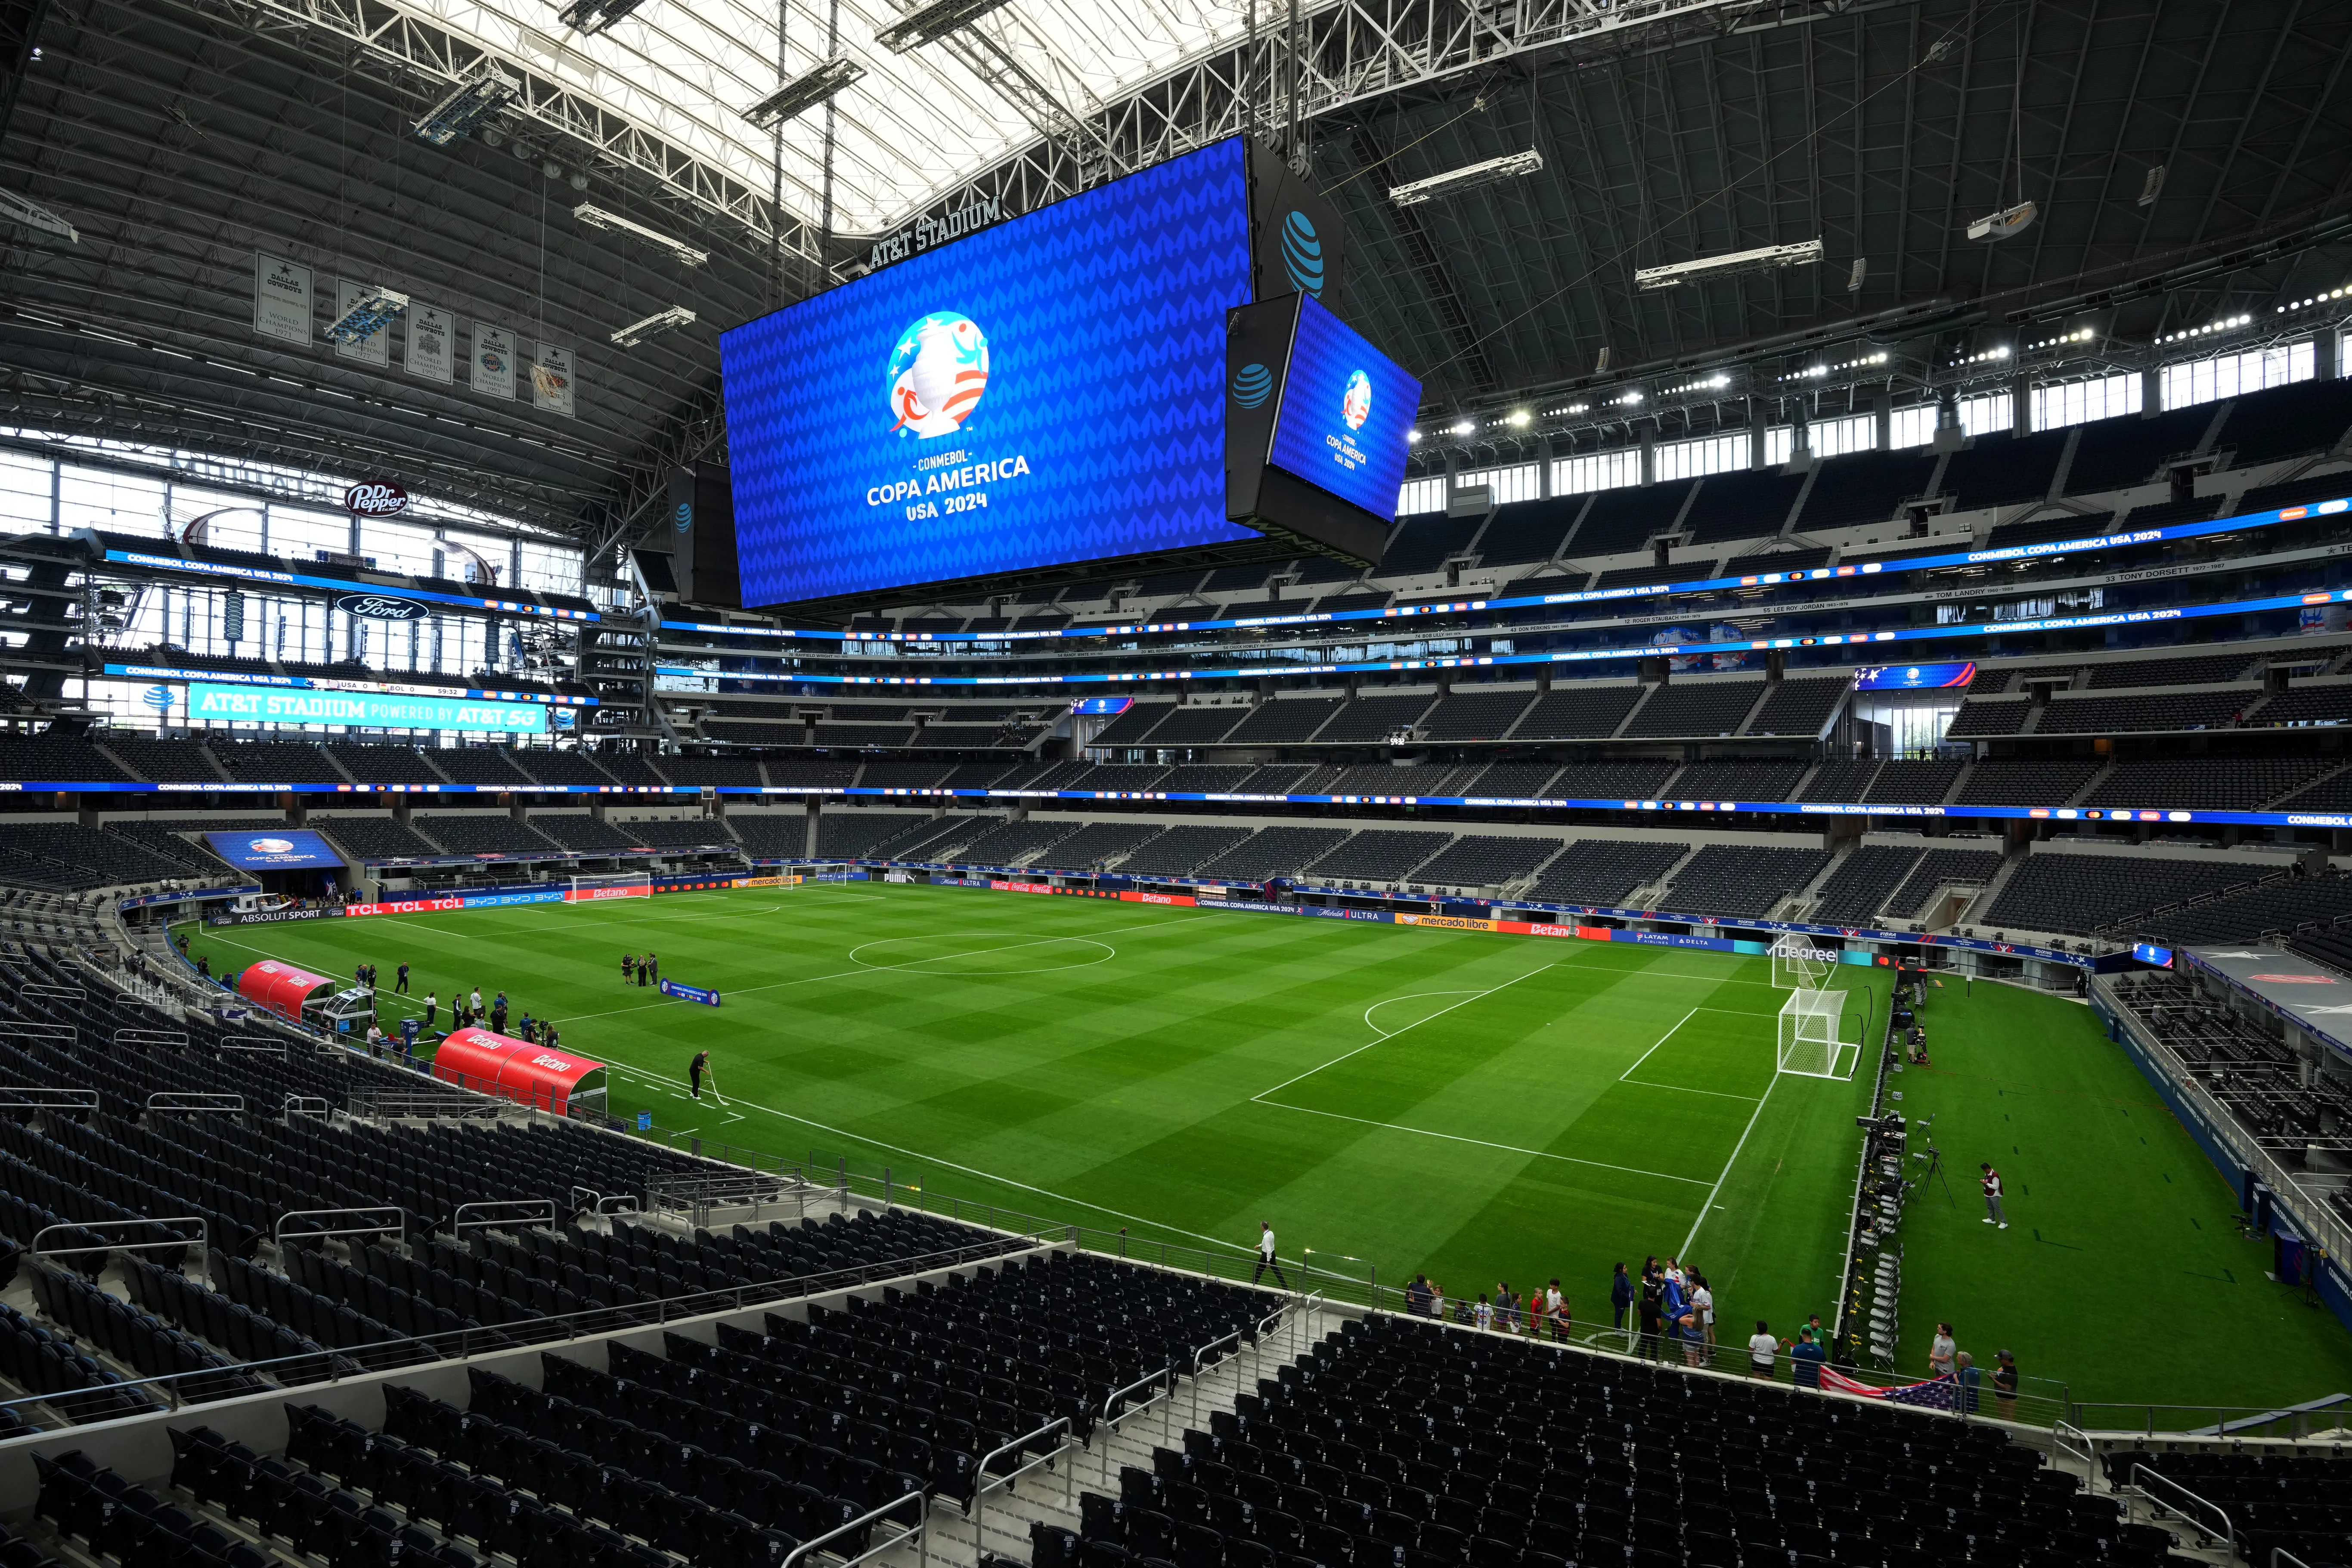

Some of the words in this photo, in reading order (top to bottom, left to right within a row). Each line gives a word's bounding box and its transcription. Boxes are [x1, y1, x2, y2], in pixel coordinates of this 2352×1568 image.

[870, 231, 912, 270] AT&T
[915, 195, 1001, 251] STADIUM
[271, 273, 299, 287] DALLAS
[267, 279, 302, 294] COWBOYS
[269, 312, 298, 325] WORLD
[419, 319, 442, 330] DALLAS
[259, 316, 307, 335] CHAMPIONS
[416, 324, 445, 336] COWBOYS
[276, 328, 291, 338] 1971
[481, 344, 508, 355] COWBOYS
[484, 339, 505, 349] DALLAS
[355, 351, 371, 359] 1977
[417, 353, 441, 365] WORLD
[409, 358, 449, 373] CHAMPIONS
[542, 363, 567, 373] COWBOYS
[545, 358, 565, 367] DALLAS
[422, 369, 437, 377] 1992
[483, 372, 505, 383] WORLD
[475, 377, 511, 390] CHAMPIONS
[1326, 434, 1342, 451] COPA
[1342, 444, 1367, 465] AMERICA
[1335, 452, 1343, 465] USA
[1344, 458, 1355, 471] 2024
[867, 479, 921, 506] COPA
[926, 455, 1030, 495] AMERICA
[372, 485, 395, 499] Dr
[348, 485, 406, 512] Pepper
[906, 502, 938, 521] USA
[945, 493, 987, 514] 2024
[1968, 547, 2027, 561] CONMEBOL
[2027, 545, 2058, 555] COPA
[2058, 539, 2107, 552] AMERICA
[2110, 535, 2132, 545] USA
[2133, 531, 2161, 542] 2024
[127, 554, 184, 568] CONMEBOL
[184, 561, 211, 572] COPA
[211, 565, 253, 577] AMERICA
[254, 570, 272, 580] USA
[272, 573, 294, 582] 2024
[2120, 573, 2142, 581] TONY
[2146, 567, 2189, 578] DORSETT
[354, 598, 413, 618] Ford
[1984, 620, 2043, 632] CONMEBOL
[2044, 619, 2074, 628] COPA
[2074, 615, 2126, 626] AMERICA
[2152, 610, 2181, 619] 2024
[201, 692, 262, 713] AT&T
[267, 695, 365, 718] STADIUM
[371, 703, 433, 719] POWERED
[438, 707, 452, 721] BY
[456, 707, 504, 725] AT&T
[507, 710, 536, 726] 5G
[2287, 815, 2348, 825] CONMEBOL
[751, 877, 781, 885] mercado
[884, 874, 906, 883] PUMA
[991, 881, 1009, 890] Coca-Cola
[1012, 883, 1030, 892] Coca-Cola
[1032, 885, 1051, 894] Coca-Cola
[594, 889, 628, 898] Betano
[1142, 893, 1171, 904] Betano
[431, 899, 463, 910] TCL
[465, 898, 497, 906] BYD
[501, 896, 530, 904] BYD
[1201, 899, 1230, 908] CONMEBOL
[347, 905, 382, 915] TCL
[390, 902, 424, 912] TCL
[241, 912, 287, 923] ABSOLUT
[289, 910, 321, 919] SPORT
[1351, 911, 1378, 920] ULTRA
[1422, 917, 1465, 927] mercado
[1467, 919, 1489, 929] libre
[1779, 947, 1836, 962] Degree
[258, 964, 278, 973] Betano
[287, 976, 310, 987] Betano
[466, 1034, 502, 1050] Betano
[531, 1054, 571, 1072] Betano
[2328, 1266, 2349, 1297] CONMEBOL
